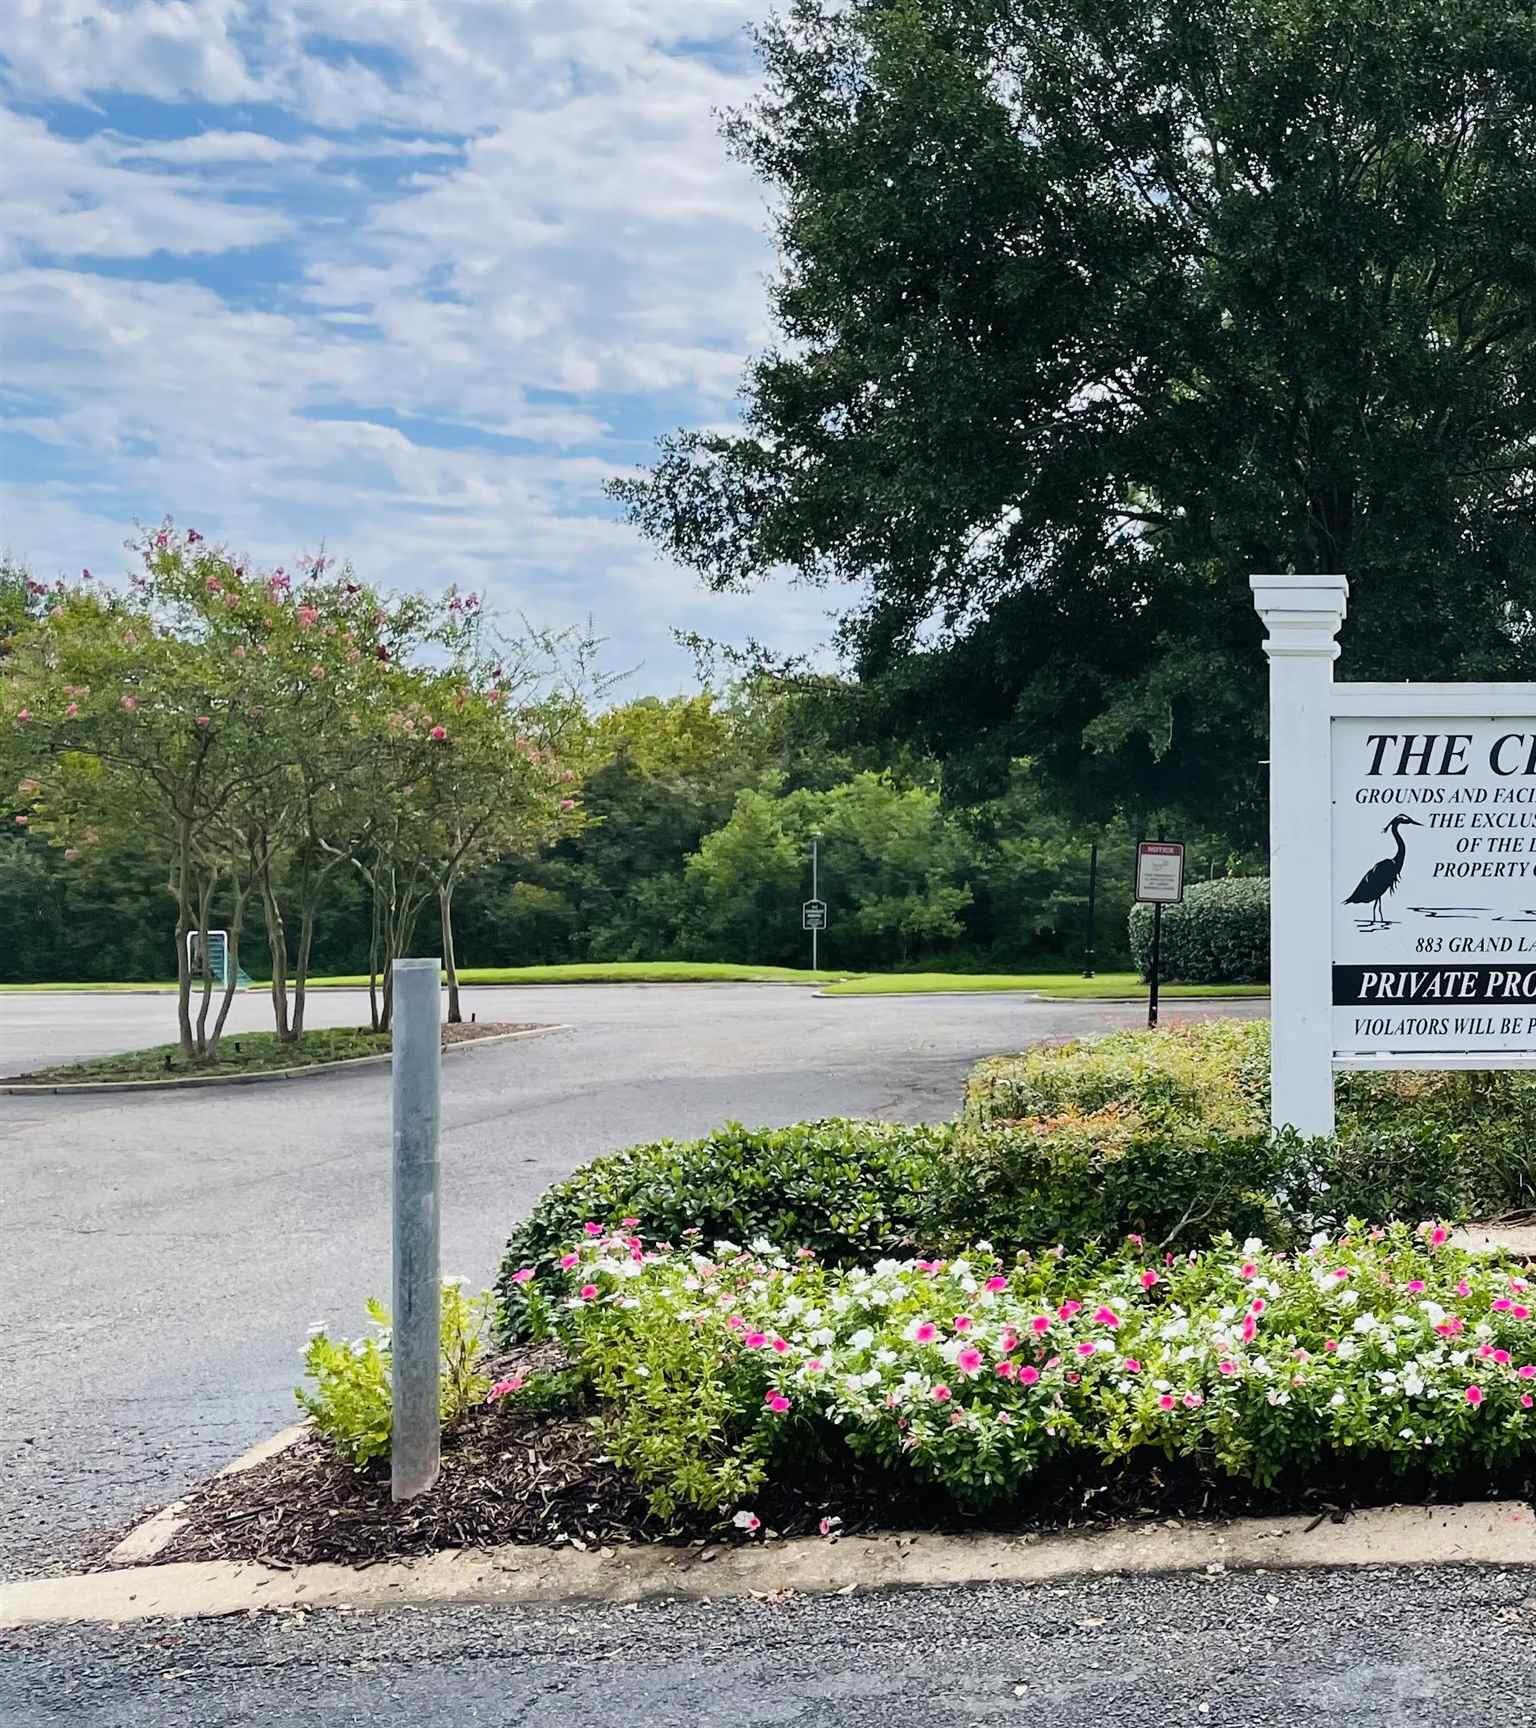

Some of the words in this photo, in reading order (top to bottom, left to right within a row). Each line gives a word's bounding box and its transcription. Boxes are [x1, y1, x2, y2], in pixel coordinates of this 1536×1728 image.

[1364, 734, 1474, 776] THE
[1355, 787, 1446, 805] GROUNDS
[1447, 788, 1488, 804] AND
[1429, 812, 1467, 829] THE
[1456, 837, 1483, 853] OF
[1487, 837, 1525, 853] THE
[1432, 861, 1531, 879] PROPERTY
[1415, 936, 1444, 953] 883
[1448, 936, 1513, 953] GRAND
[1357, 971, 1479, 999] PRIVATE
[1355, 1017, 1450, 1036] VIOLATORS
[1454, 1017, 1496, 1035] WILL
[1499, 1017, 1524, 1035] BE
